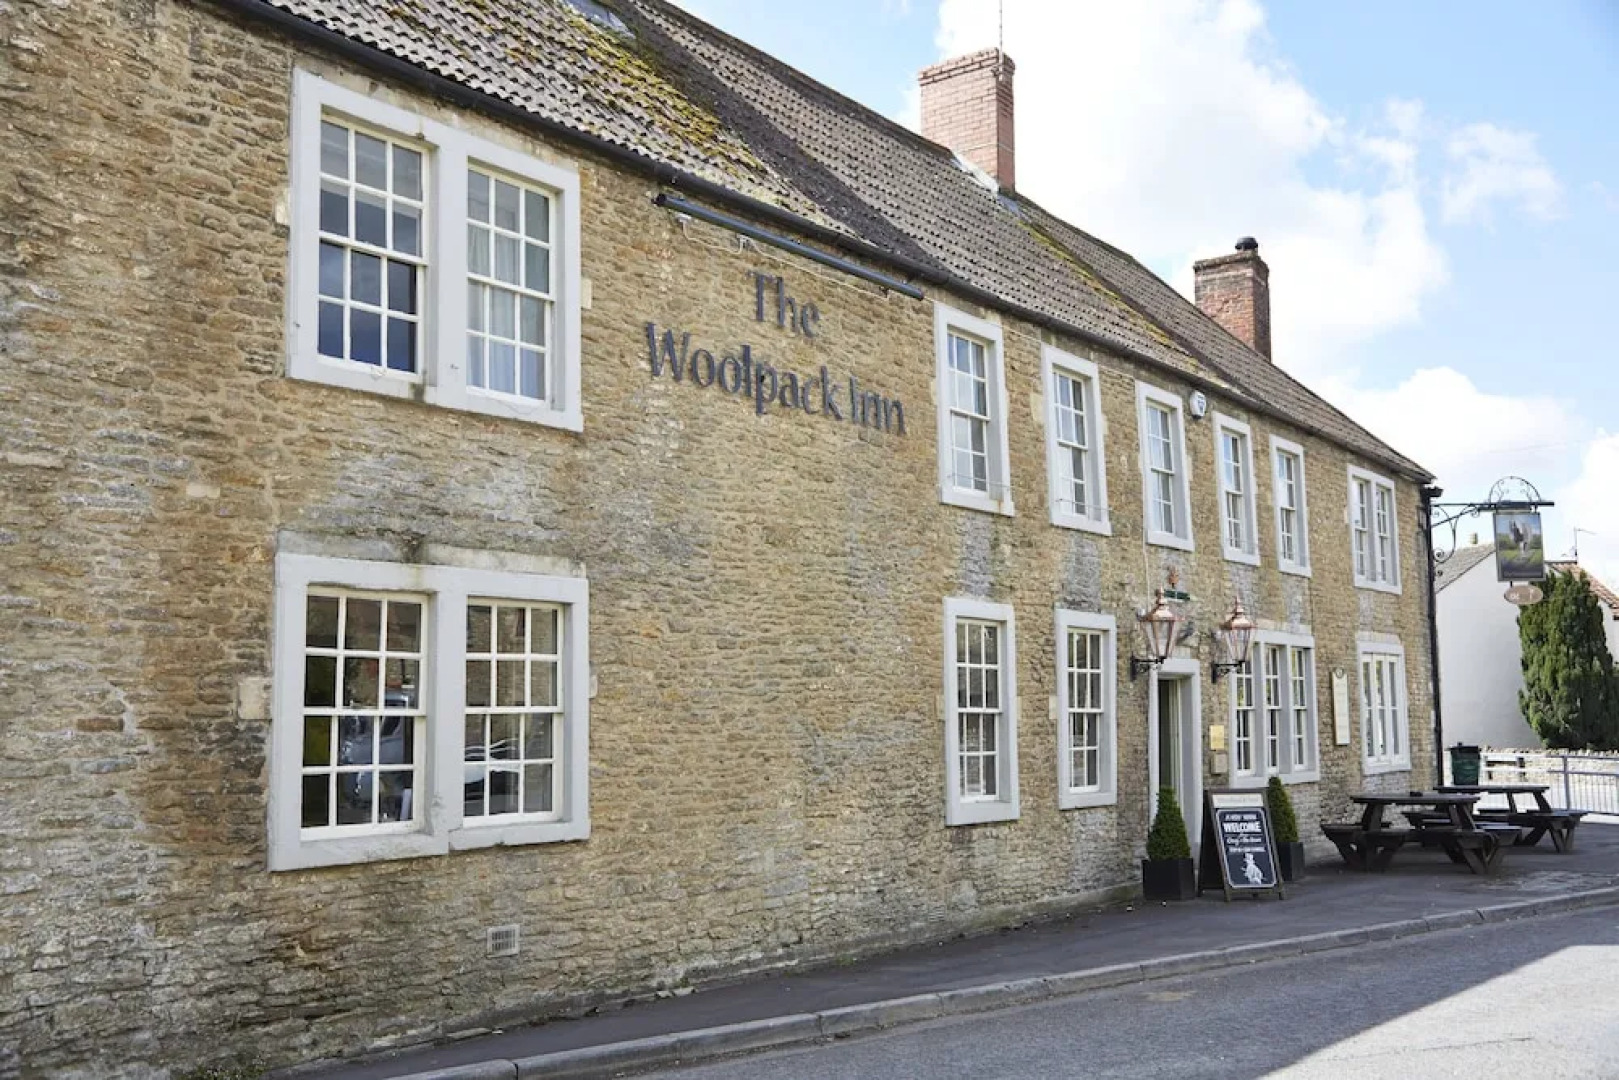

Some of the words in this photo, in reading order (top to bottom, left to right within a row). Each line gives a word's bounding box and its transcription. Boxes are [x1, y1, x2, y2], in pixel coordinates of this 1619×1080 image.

[748, 271, 820, 338] The
[645, 321, 843, 422] Woolpack
[849, 376, 906, 436] Inn
[1223, 821, 1262, 833] WELCOME
